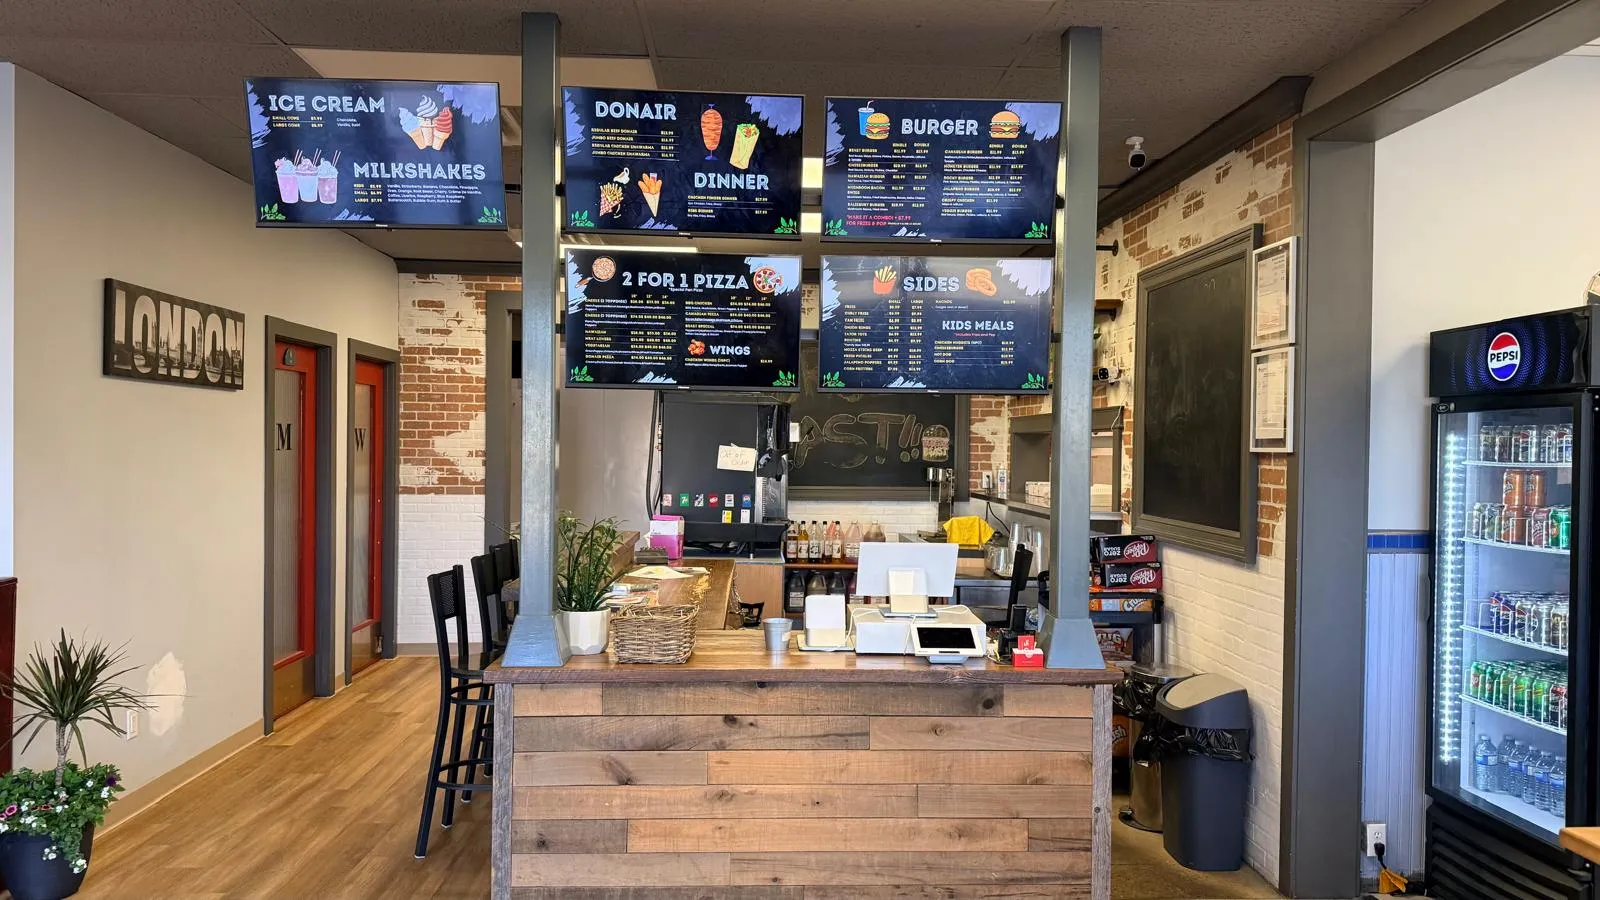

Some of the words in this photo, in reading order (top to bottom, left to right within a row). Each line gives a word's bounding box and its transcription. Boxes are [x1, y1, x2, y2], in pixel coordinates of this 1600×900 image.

[269, 95, 306, 111] ICE
[312, 96, 385, 112] CREAM
[596, 101, 676, 120] DONAIR
[901, 119, 978, 136] BURGER
[354, 162, 486, 180] MILKSHAKES
[694, 172, 769, 190] DINNER
[622, 272, 632, 286] 2
[638, 272, 674, 288] FOR
[680, 274, 688, 288] 1
[694, 274, 749, 290] PIZZA
[903, 276, 960, 292] SIDES
[942, 321, 972, 330] KIDS
[975, 321, 1014, 330] MEALS
[114, 289, 243, 385] LONDON
[710, 345, 750, 355] WINGS
[1490, 351, 1518, 362] PEPSI
[275, 423, 292, 451] M
[354, 428, 366, 451] W
[1123, 598, 1148, 612] Cru
